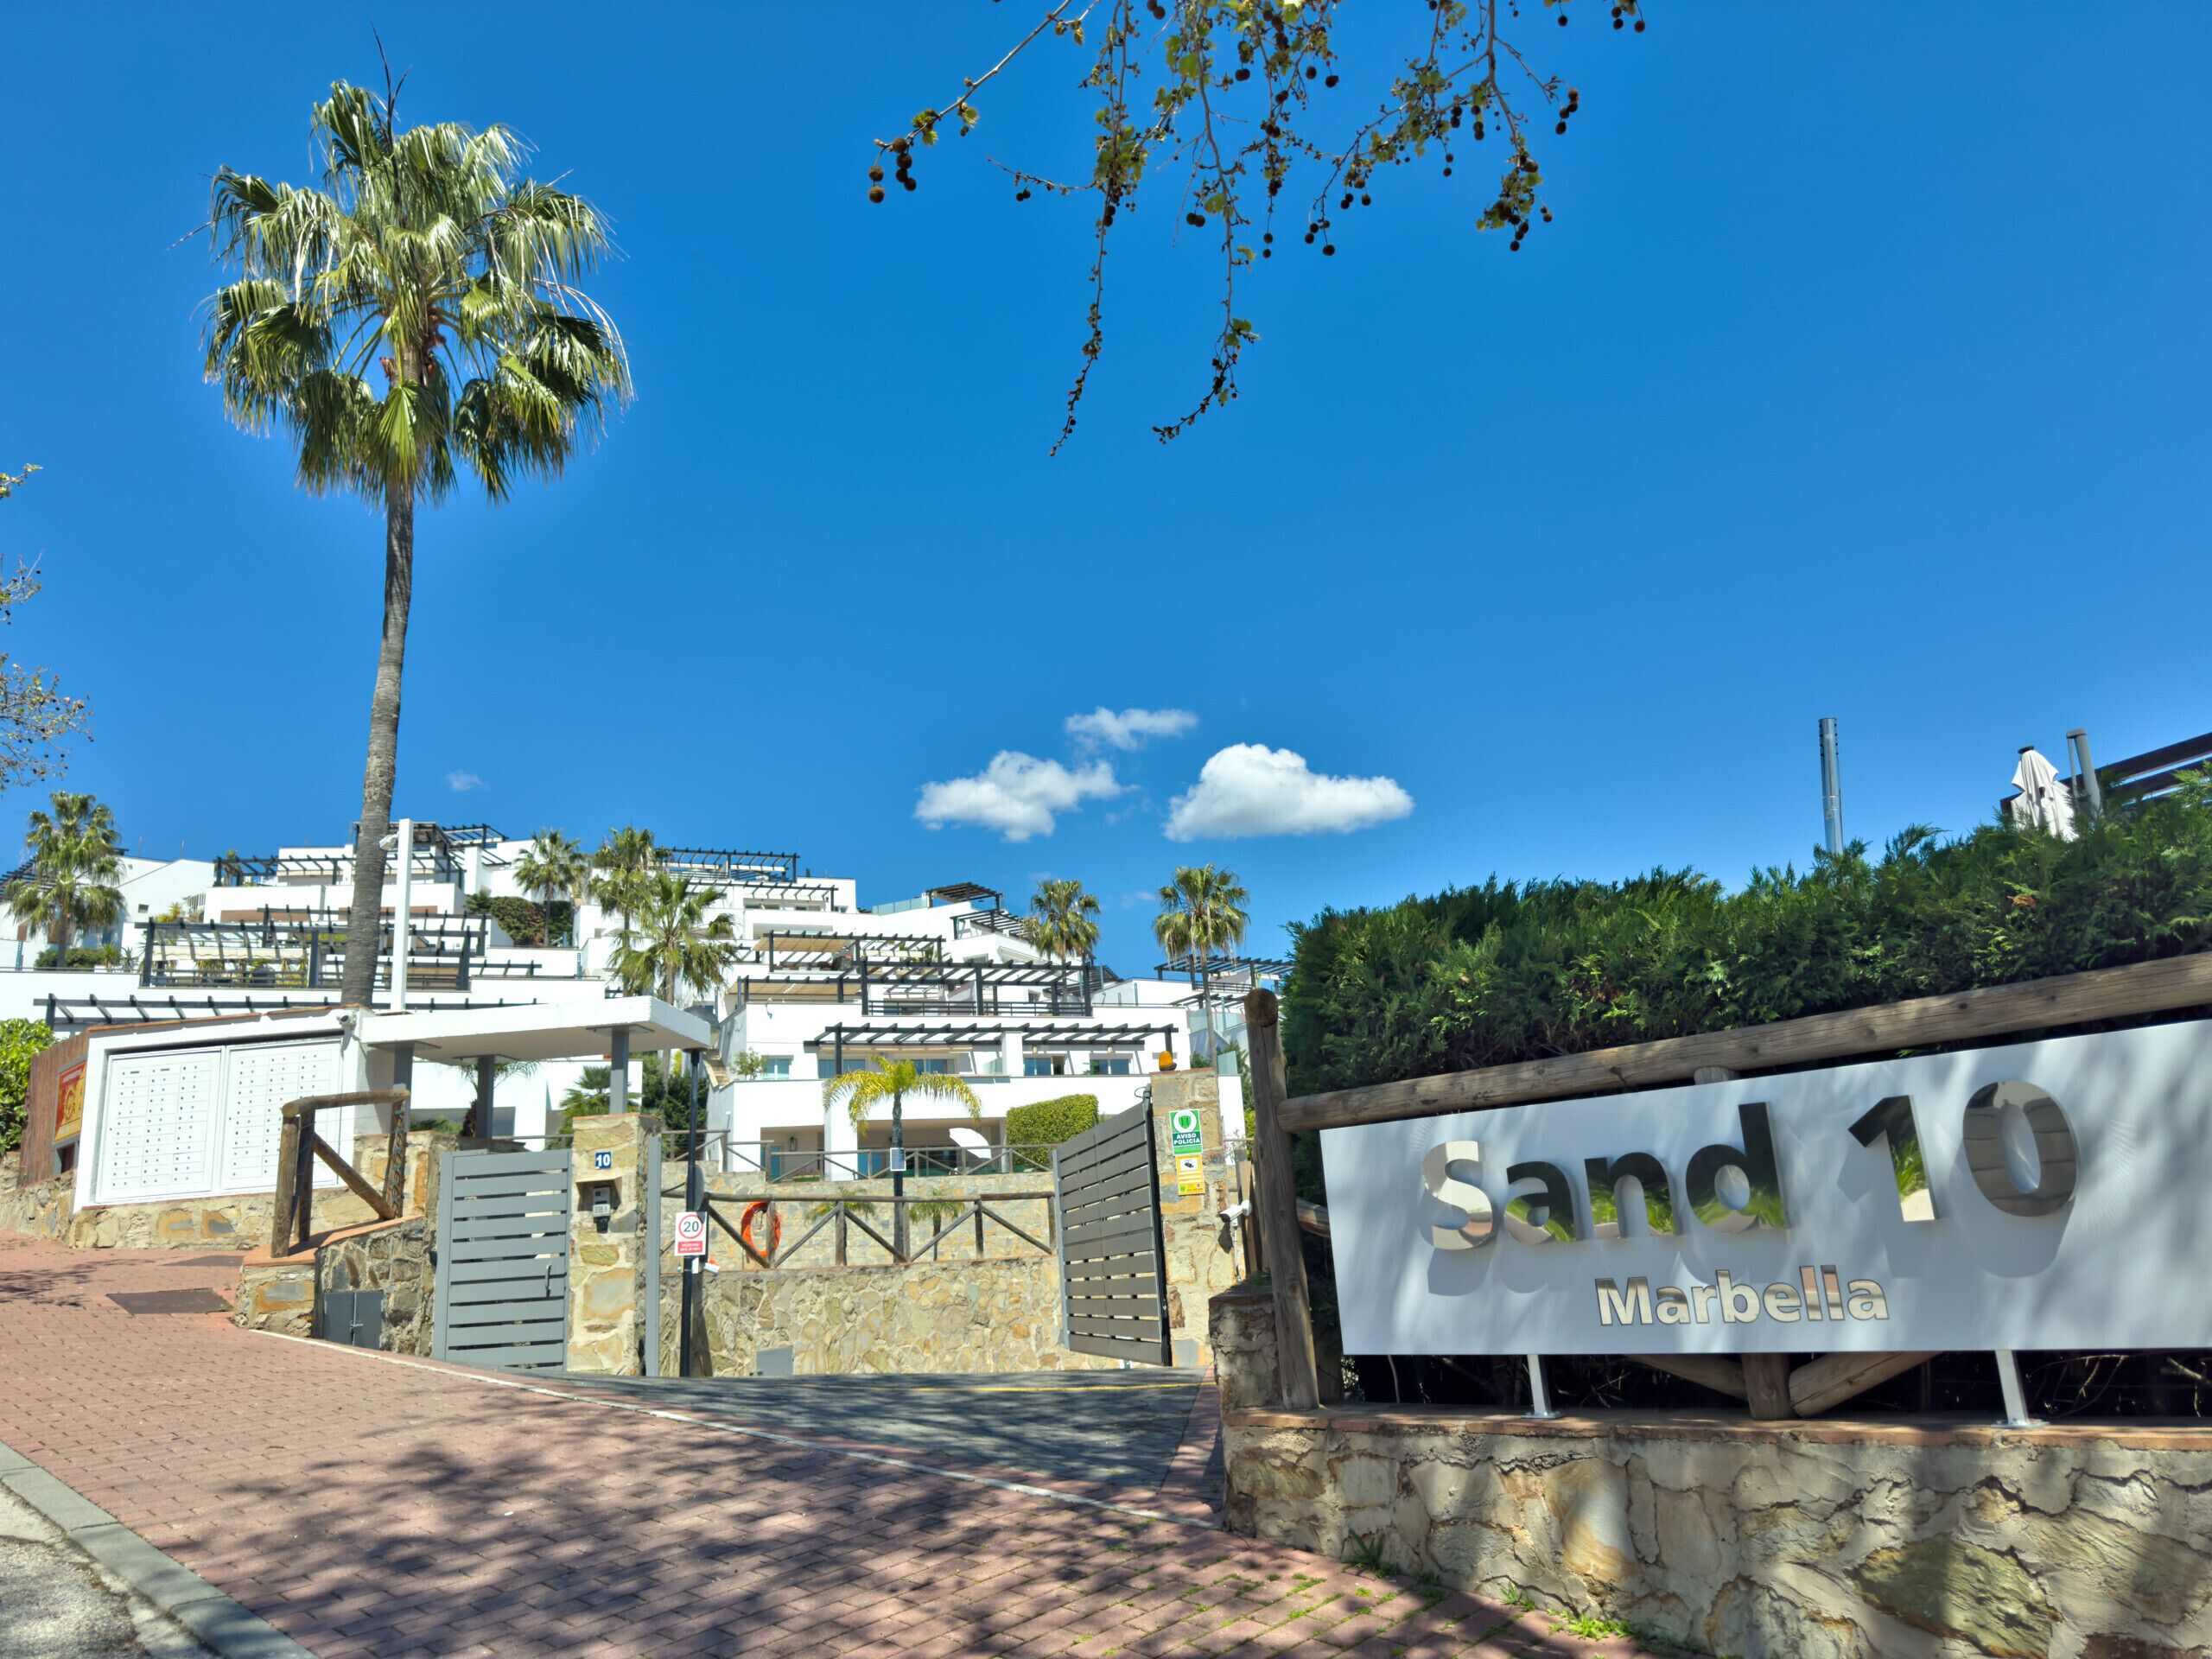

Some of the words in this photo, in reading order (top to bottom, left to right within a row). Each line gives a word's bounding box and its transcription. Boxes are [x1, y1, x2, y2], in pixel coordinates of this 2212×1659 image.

[595, 1154, 610, 1167] 10
[1422, 1102, 1786, 1250] Sand
[1847, 1080, 2078, 1223] 10
[683, 1222, 699, 1232] 20
[1594, 1264, 1890, 1326] Marbella
